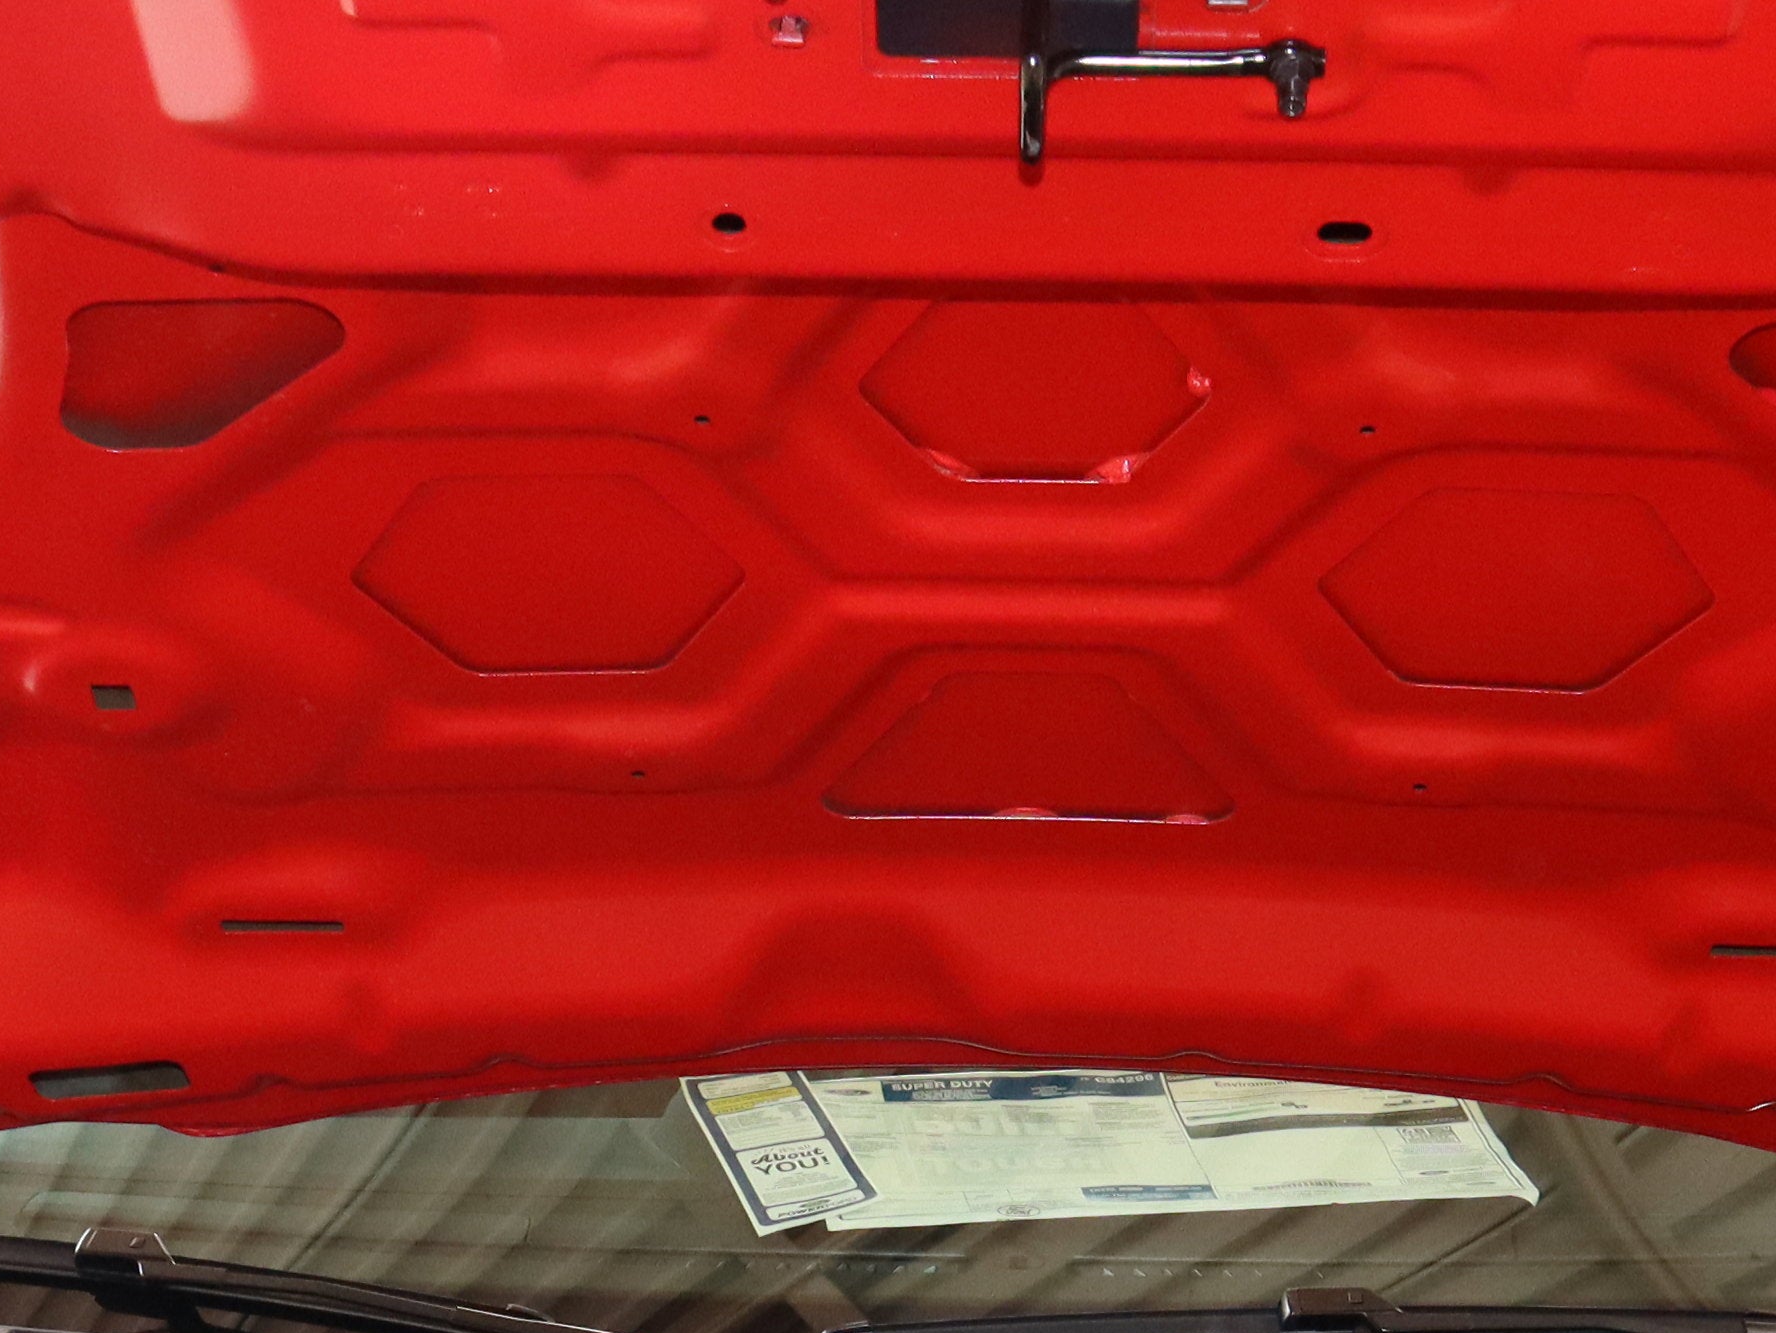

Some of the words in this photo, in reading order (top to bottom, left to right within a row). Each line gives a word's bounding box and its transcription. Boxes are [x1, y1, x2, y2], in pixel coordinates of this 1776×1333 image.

[891, 1080, 946, 1091] SUPER
[949, 1079, 993, 1089] DUTY
[751, 1147, 825, 1166] About
[754, 1155, 830, 1176] YOU!
